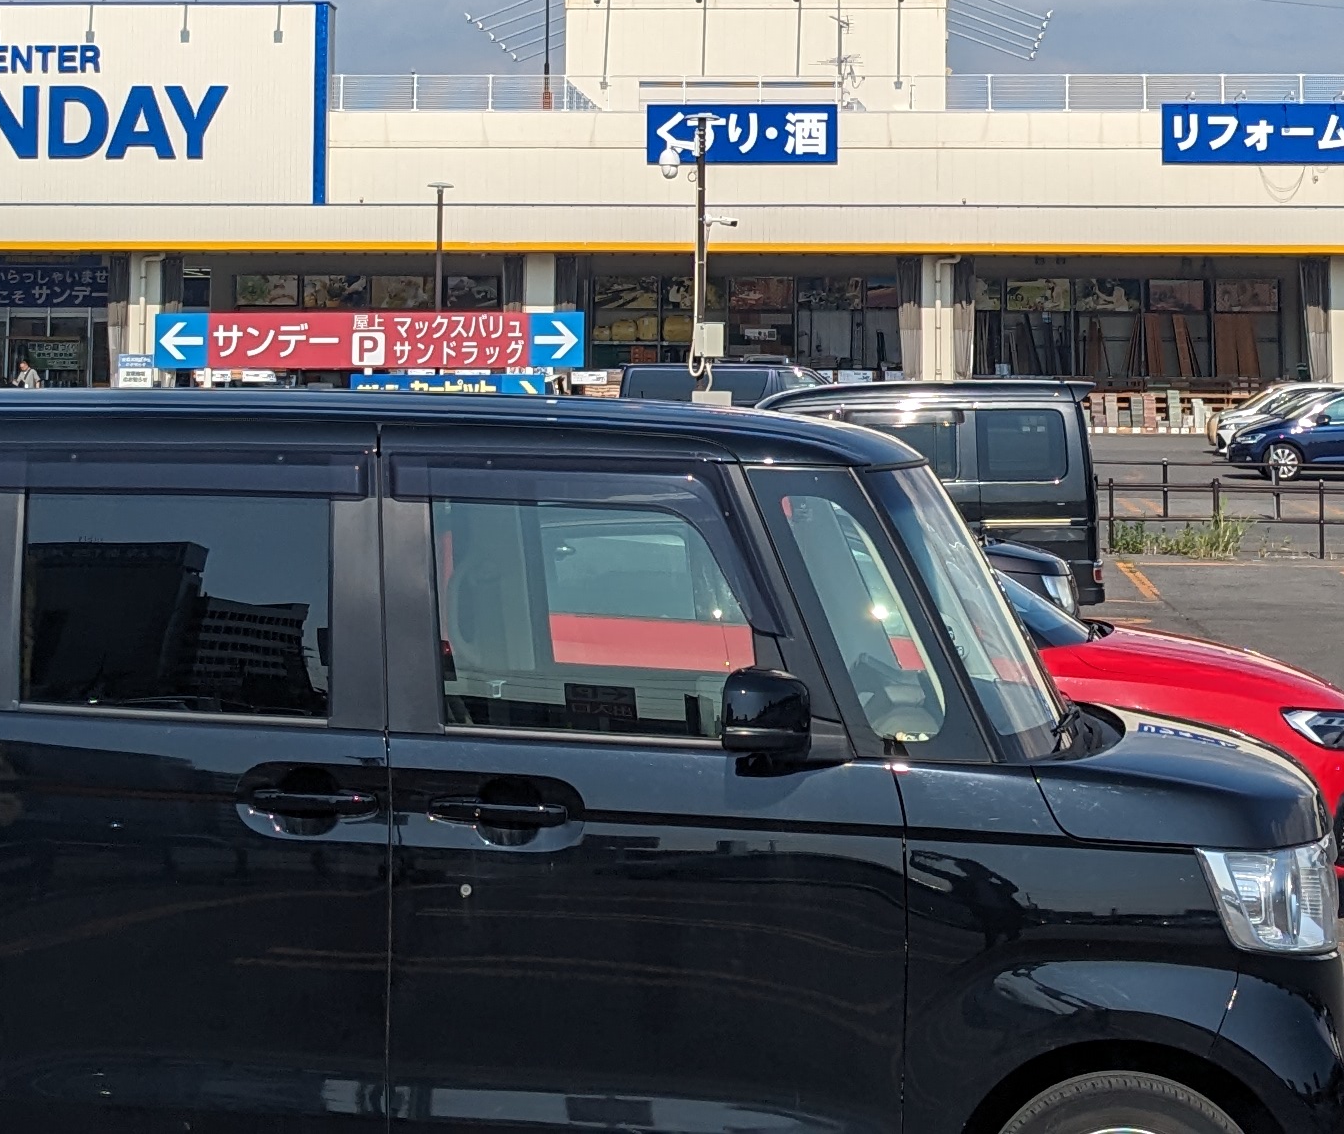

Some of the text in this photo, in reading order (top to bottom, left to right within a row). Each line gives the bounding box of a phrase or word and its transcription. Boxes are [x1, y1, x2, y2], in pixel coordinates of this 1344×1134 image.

[353, 314, 385, 330] 屋上
[393, 314, 523, 340] マックスバリュ
[213, 322, 339, 357] サンデー
[359, 338, 379, 361] P
[393, 339, 524, 365] サンドラッグ
